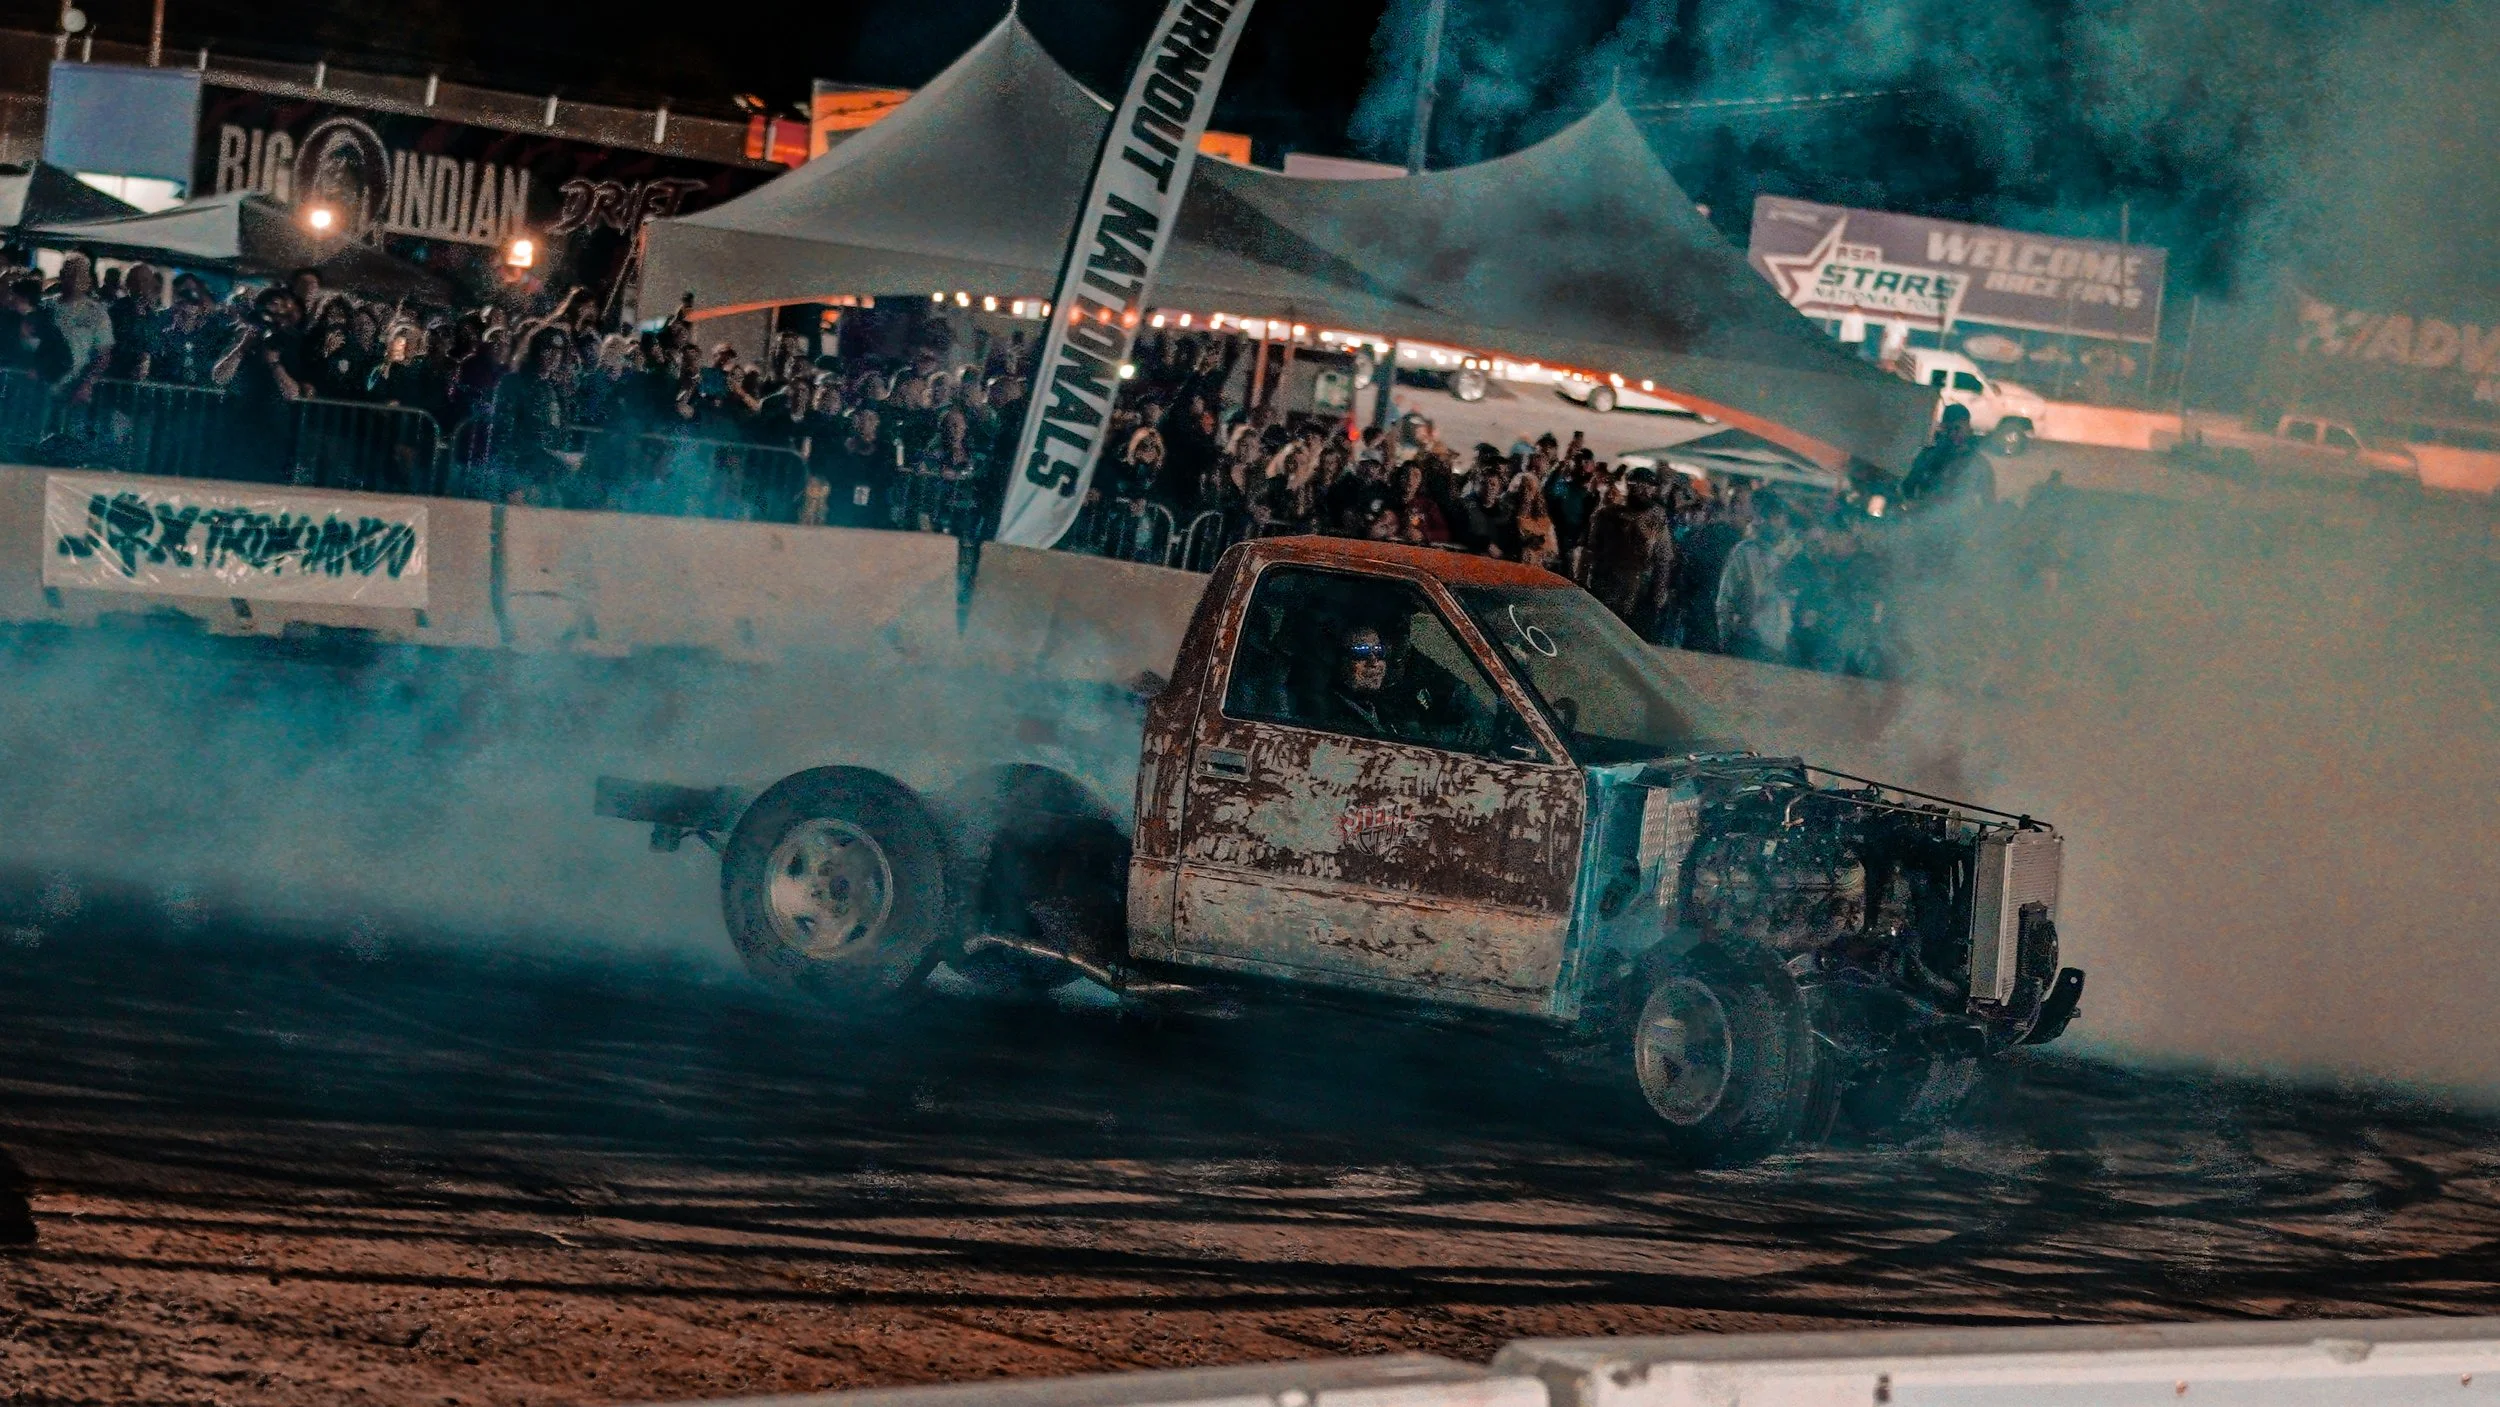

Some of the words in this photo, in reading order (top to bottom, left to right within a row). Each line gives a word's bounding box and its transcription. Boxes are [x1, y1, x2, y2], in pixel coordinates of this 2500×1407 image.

[216, 124, 294, 197] BIG
[388, 150, 531, 240] INDIAN
[1819, 265, 1959, 300] STARS
[1928, 231, 2142, 287] WELCOME
[1023, 193, 1161, 499] NATIONALS
[1508, 604, 1558, 657] 6
